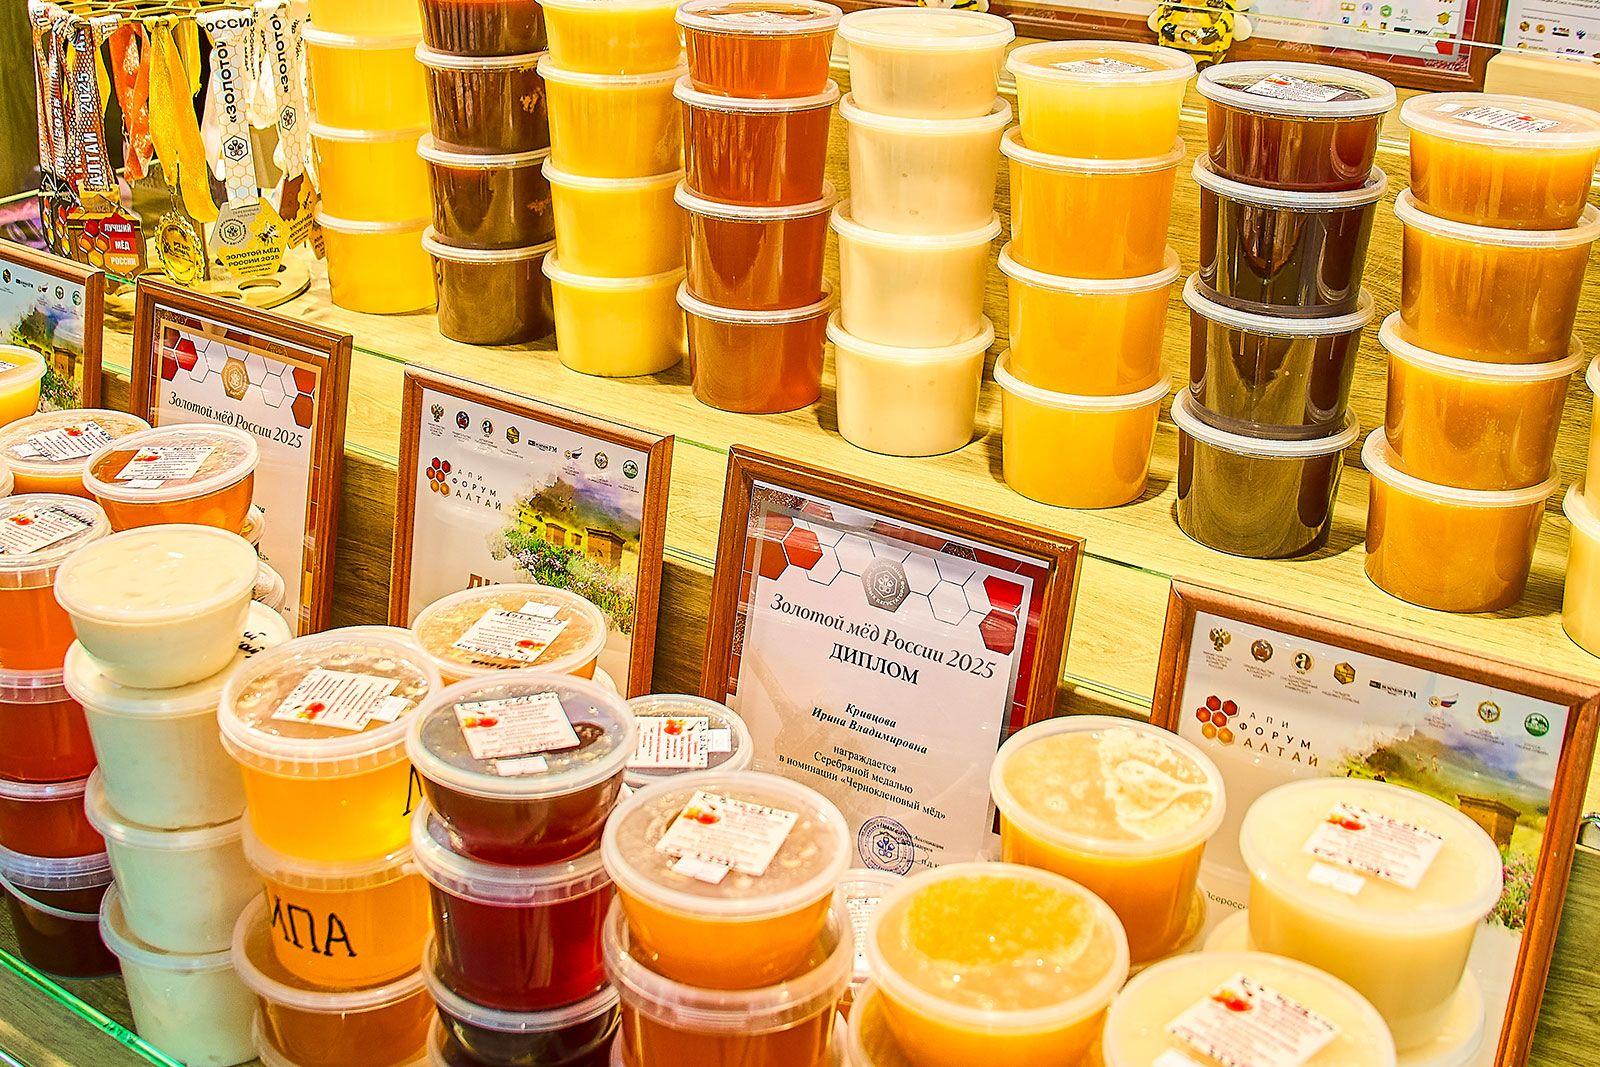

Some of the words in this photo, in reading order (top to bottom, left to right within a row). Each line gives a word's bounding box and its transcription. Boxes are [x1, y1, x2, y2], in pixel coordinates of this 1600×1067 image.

[206, 18, 256, 32] ОССИИ
[79, 71, 93, 113] 2025
[84, 131, 103, 187] АЛТАЙ
[104, 223, 132, 233] ЛУЧШИЙ
[115, 240, 130, 251] МЁД
[226, 248, 262, 260] ЗОЛОТОЙ
[263, 246, 280, 256] МЁД
[110, 257, 136, 266] РОССИИ
[228, 257, 260, 267] РОССИИ
[168, 391, 213, 419] Золотой
[213, 408, 233, 425] мёд
[234, 414, 272, 438] России
[273, 426, 304, 449] 2025
[452, 477, 498, 498] ФОРУМ
[457, 468, 483, 481] АПИ
[455, 490, 502, 511] АЛТАЙ
[770, 593, 845, 631] Золотой
[846, 620, 880, 643] мёд
[882, 628, 943, 663] России
[946, 650, 997, 680] 2025
[829, 642, 920, 685] ДИПЛОМ
[845, 703, 897, 729] Кривцова
[1249, 712, 1289, 729] АПИ
[812, 707, 847, 727] Ирина
[849, 719, 928, 755] Владимировна
[1239, 722, 1312, 750] ФОРУМ
[833, 746, 897, 774] награждается
[1243, 738, 1319, 767] АЛТАЙ
[814, 751, 869, 779] Серебряной
[872, 773, 913, 795] медалью
[779, 754, 785, 762] в
[786, 756, 838, 782] номинации
[841, 776, 920, 811] «Чернокленовый
[923, 805, 946, 820] мёд»
[1206, 890, 1248, 911] серосс
[272, 894, 358, 957] ИПА
